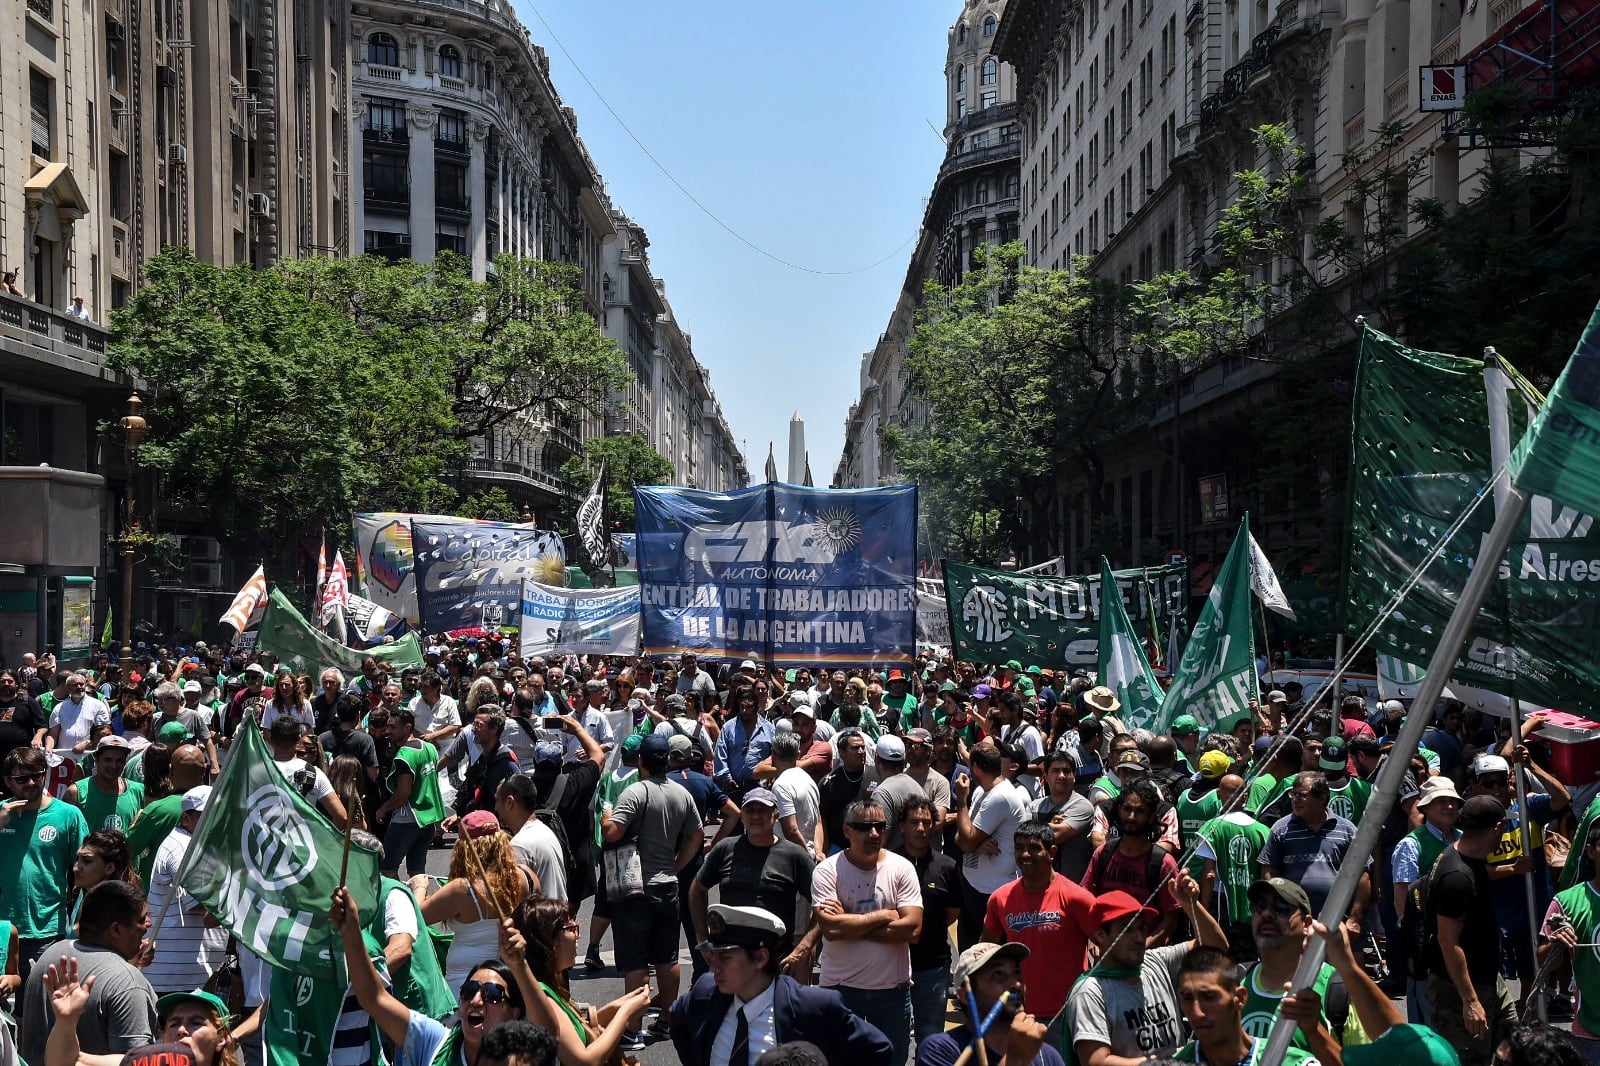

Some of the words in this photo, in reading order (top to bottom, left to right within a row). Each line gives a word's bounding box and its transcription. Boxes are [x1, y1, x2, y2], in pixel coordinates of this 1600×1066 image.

[1431, 94, 1456, 102] ENAS
[444, 540, 532, 568] Capital
[1519, 542, 1600, 582] Aires
[720, 565, 818, 582] AUTÓNOMA
[725, 587, 751, 609] DE
[533, 606, 565, 619] RADIO
[963, 585, 1014, 642] ATE
[682, 616, 710, 637] DE
[716, 616, 739, 640] LA
[743, 620, 866, 643] ARGENTINA
[1214, 680, 1241, 720] LA
